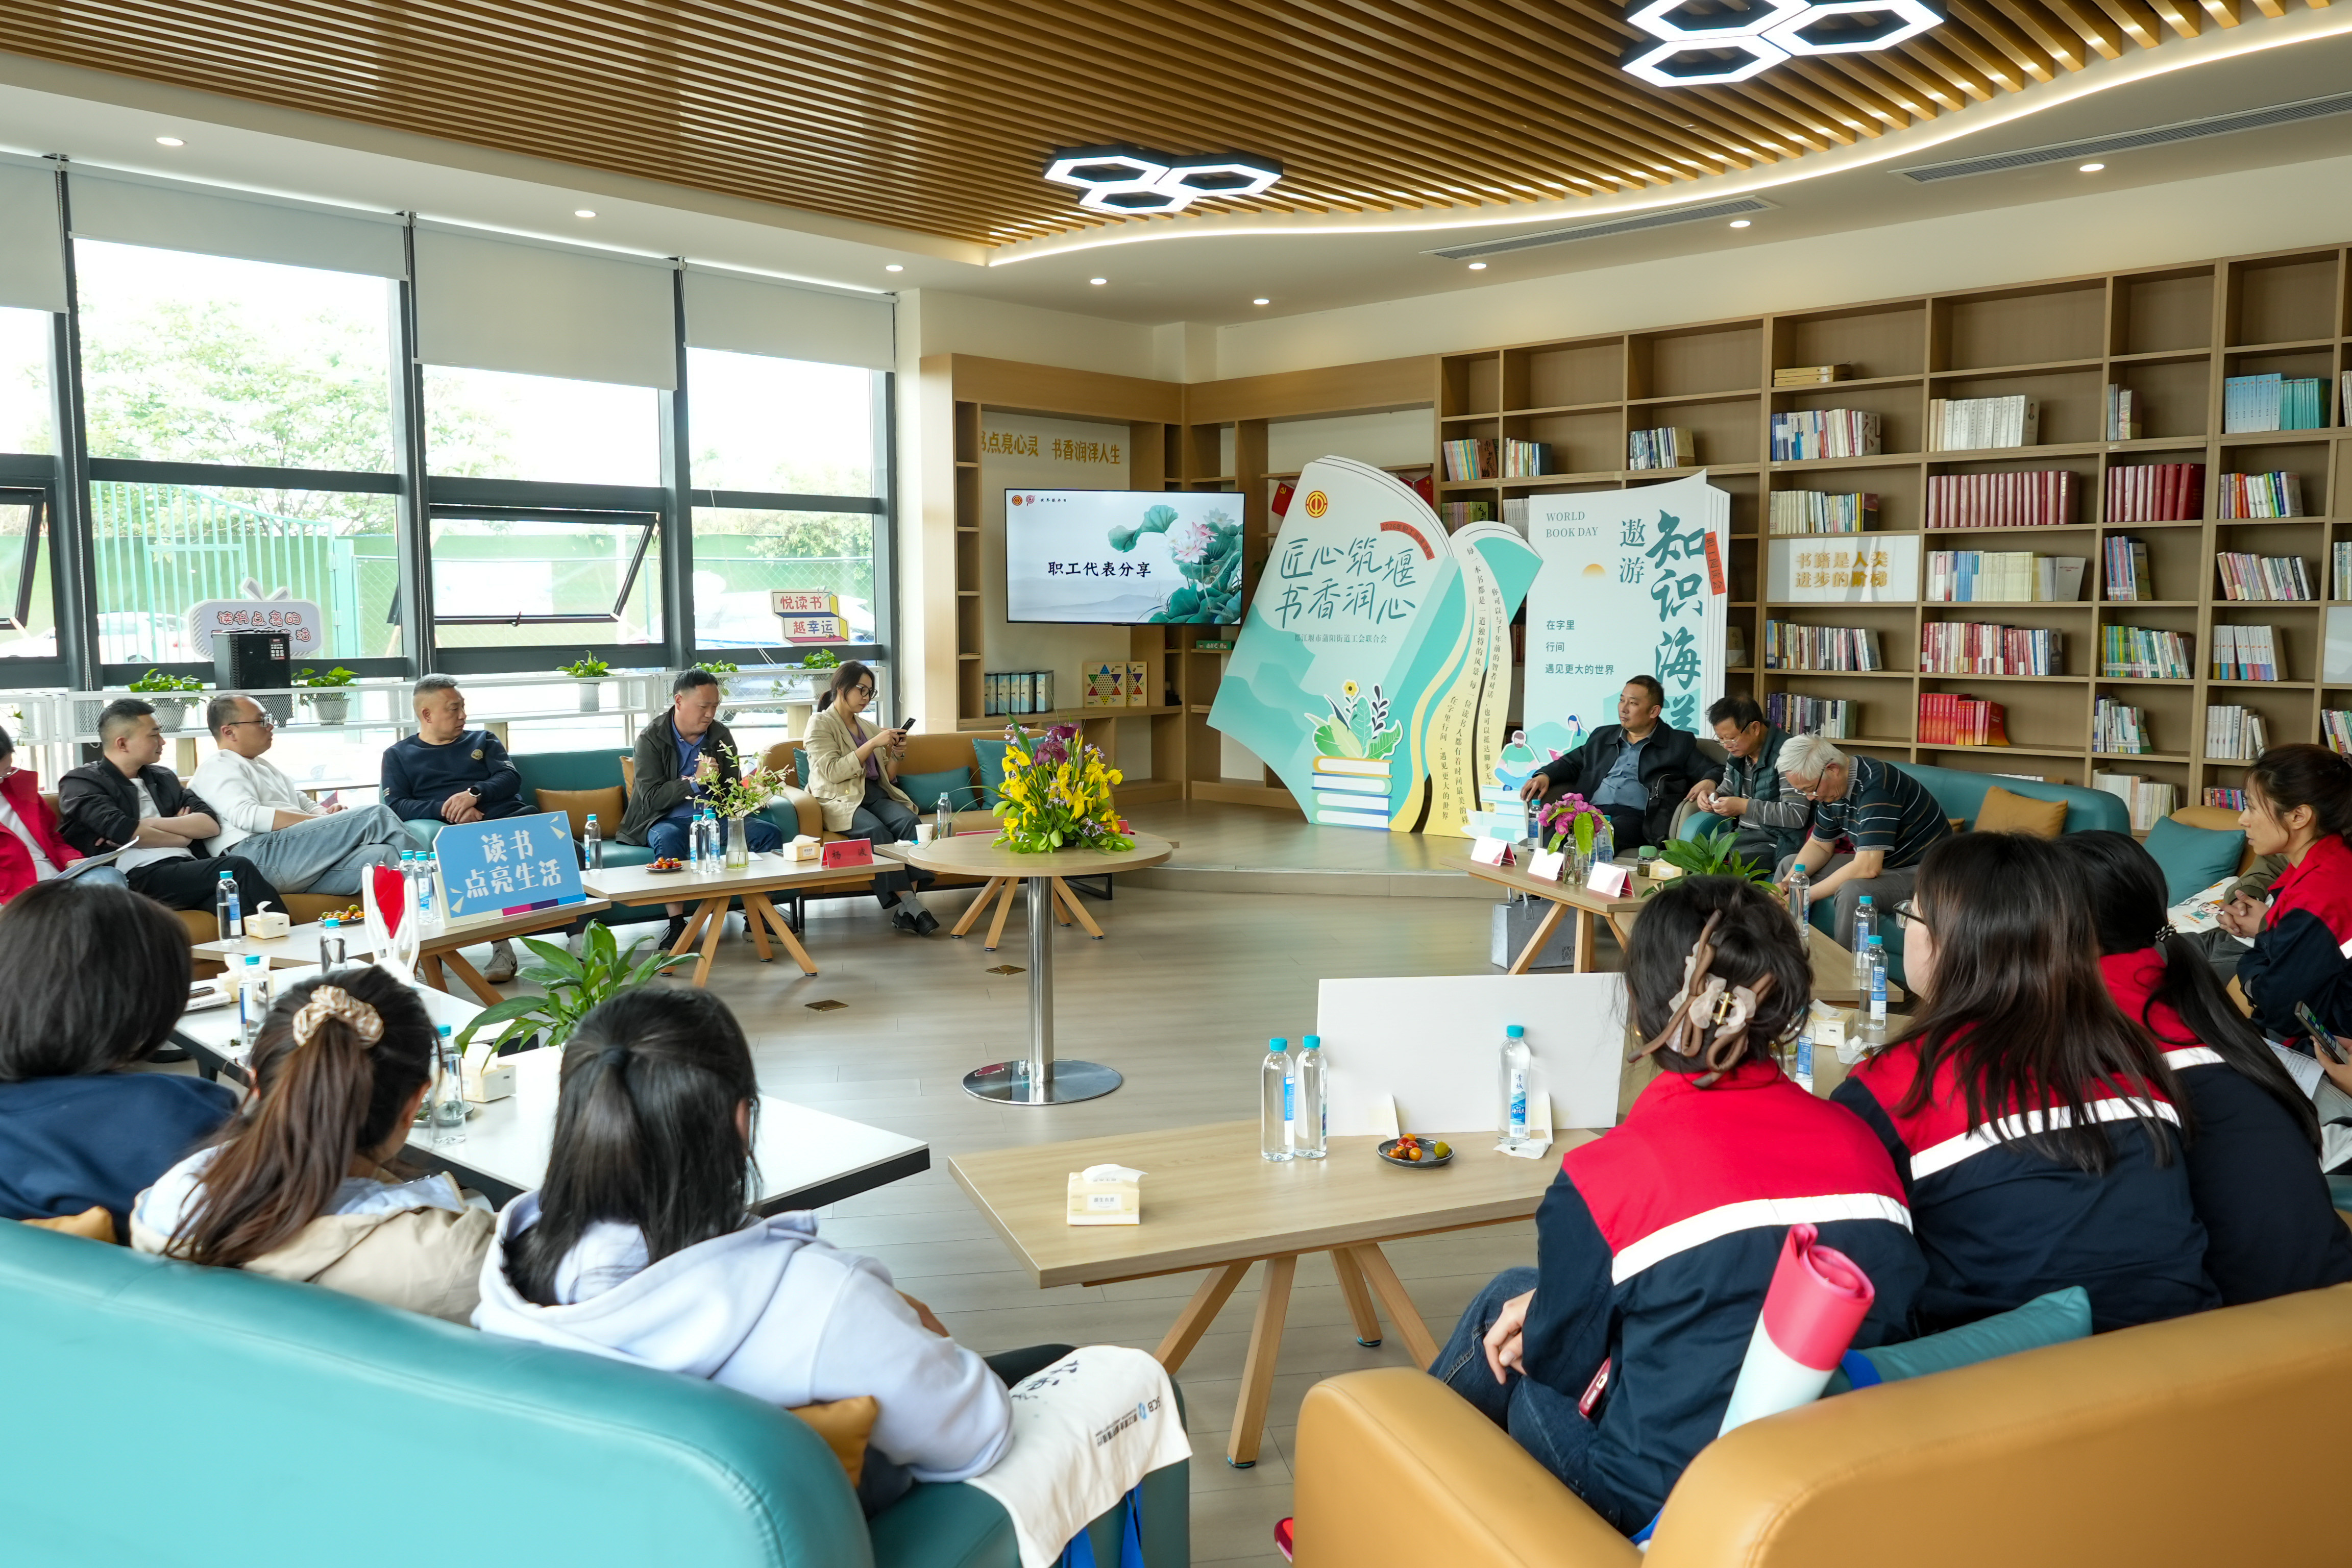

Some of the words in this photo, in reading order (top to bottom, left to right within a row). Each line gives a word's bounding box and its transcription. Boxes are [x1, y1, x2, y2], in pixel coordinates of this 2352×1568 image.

[1051, 438, 1120, 464] 书香润泽人生
[1546, 511, 1585, 522] WORLD
[1546, 528, 1576, 538] BOOK
[1578, 527, 1599, 536] DAY
[1620, 519, 1646, 584] 遨游
[1280, 537, 1414, 588] 匠心筑堰
[1796, 551, 1888, 569] 书籍是人类
[1047, 561, 1152, 578] 职工代表分享
[1796, 571, 1888, 587] 进步的阶梯
[780, 596, 823, 610] 悦读书
[1275, 577, 1416, 629] 书香润心
[217, 610, 302, 627] 读书点亮的
[1546, 620, 1575, 630] 在字里
[793, 620, 834, 634] 越幸运
[1294, 633, 1387, 643] 都江堰市蒲阳街道工会联合会
[1546, 642, 1565, 652] 行间
[1545, 664, 1614, 675] 遇见更大的世界
[480, 829, 534, 864] 读书
[465, 858, 562, 898] 点亮生活
